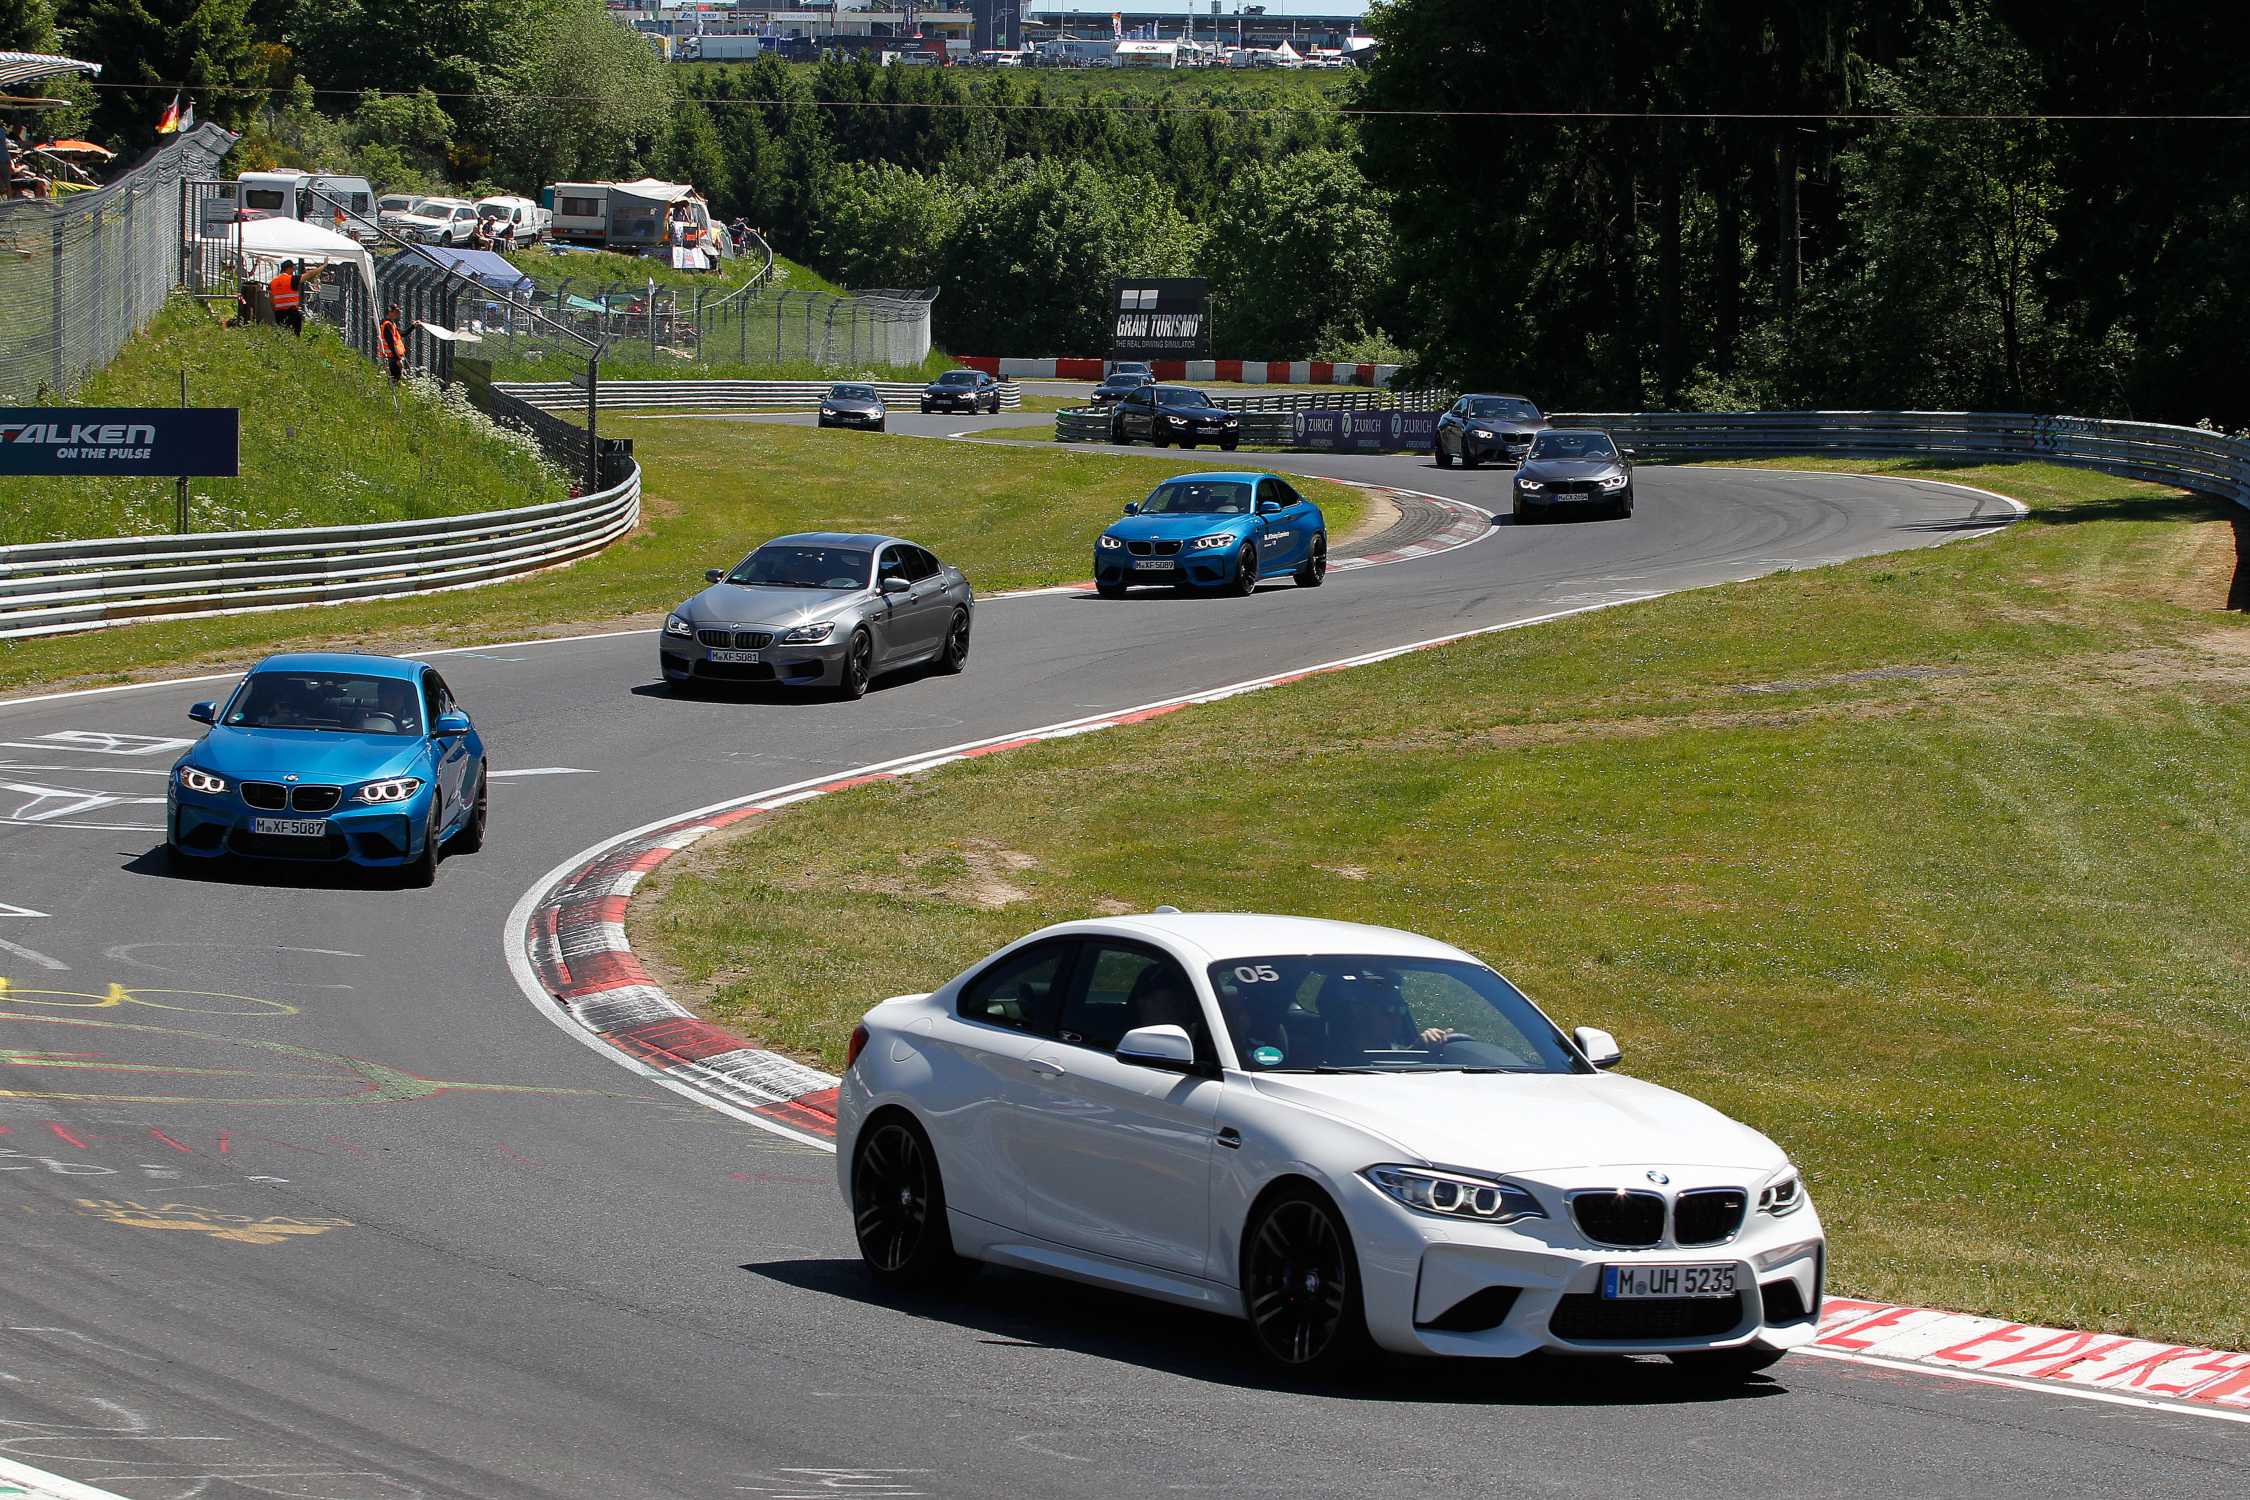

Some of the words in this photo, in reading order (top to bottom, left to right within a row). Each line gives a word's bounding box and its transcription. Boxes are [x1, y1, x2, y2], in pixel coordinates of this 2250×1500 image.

[1116, 314, 1148, 337] GRAN
[1150, 314, 1199, 337] TURISMO
[1116, 340, 1127, 348] THE
[1127, 340, 1140, 348] REAL
[1141, 340, 1164, 348] DRIVING
[1164, 340, 1195, 348] SIMULATOR
[1308, 418, 1333, 432] ZURICH
[1354, 418, 1381, 433] ZURICH
[1403, 419, 1432, 433] ZURICH
[612, 440, 625, 451] 71
[57, 448, 78, 459] ON
[81, 448, 105, 459] THE
[109, 448, 151, 459] PULSE
[256, 820, 265, 832] M
[273, 821, 288, 833] XF
[291, 821, 323, 834] 5087
[1234, 965, 1280, 984] 05
[1619, 1269, 1634, 1294] M
[1650, 1268, 1677, 1294] UH
[1685, 1267, 1735, 1293] 5235
